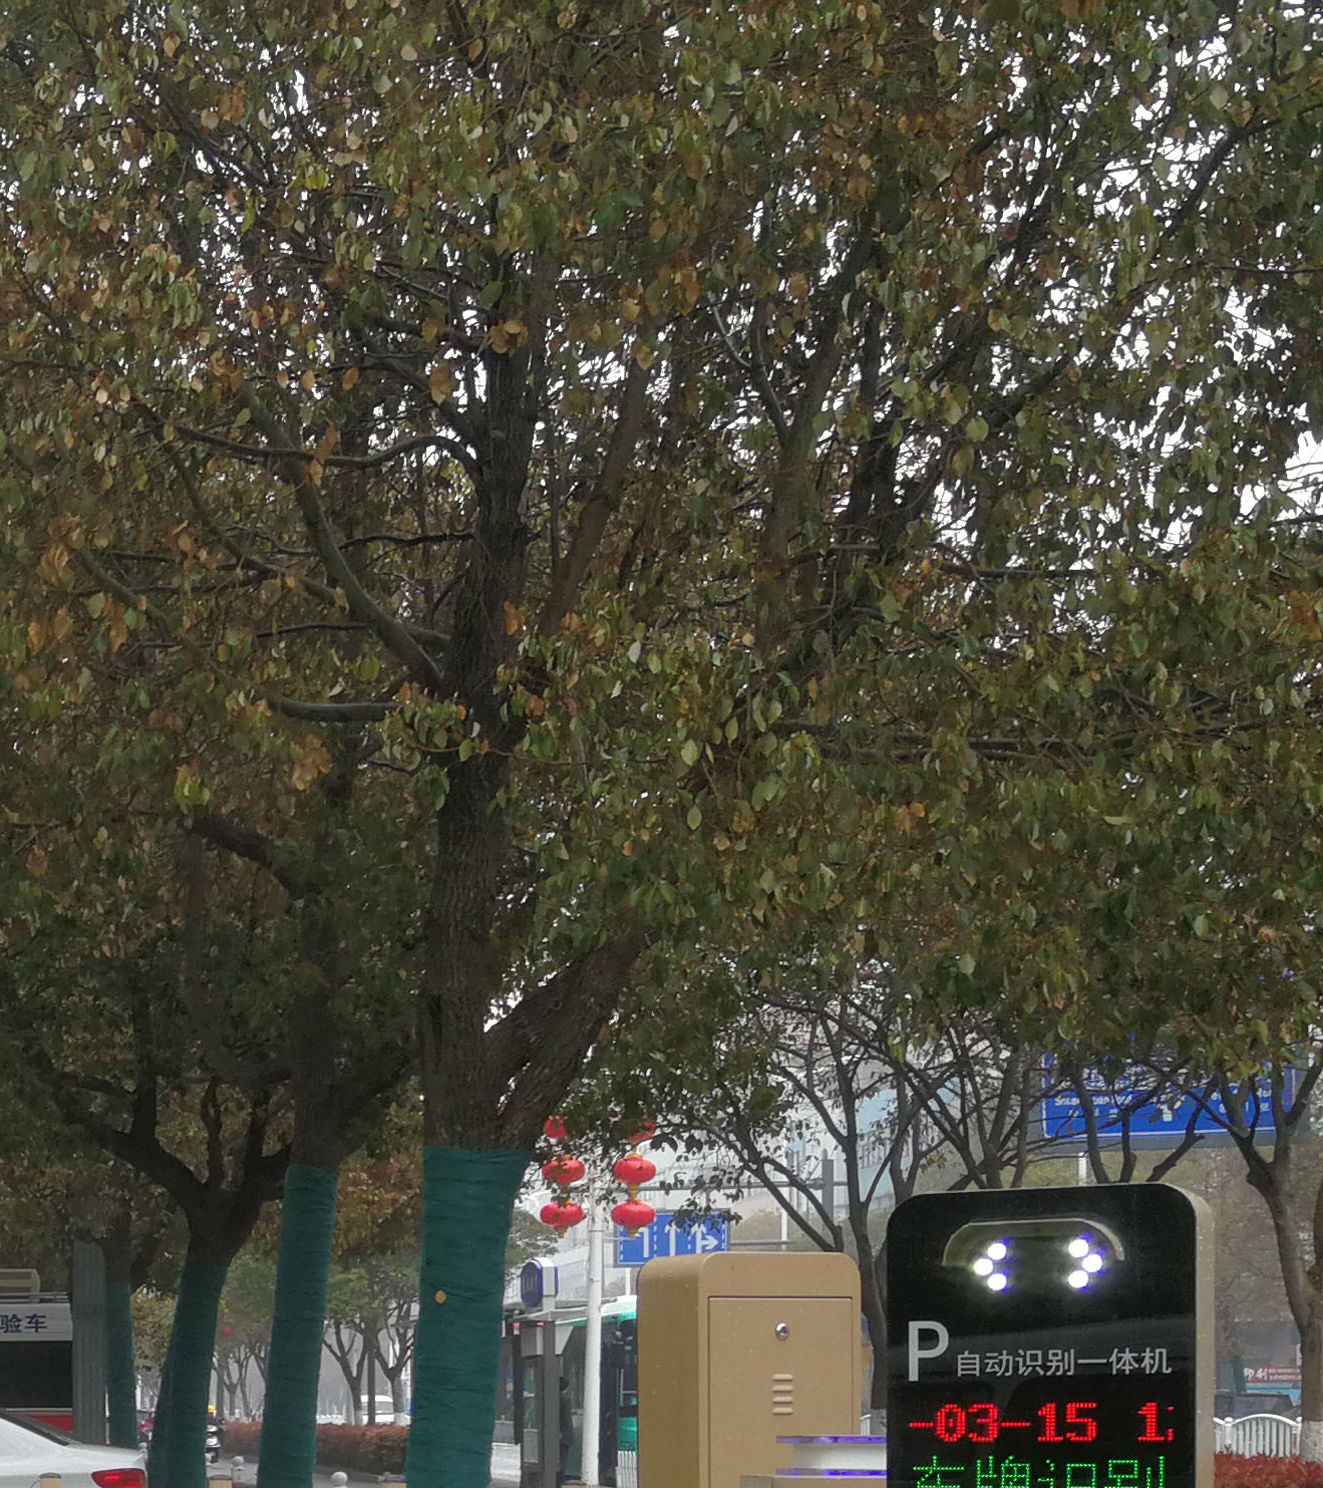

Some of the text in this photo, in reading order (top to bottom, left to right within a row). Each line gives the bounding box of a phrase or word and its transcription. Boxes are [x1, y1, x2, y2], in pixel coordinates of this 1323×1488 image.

[908, 1321, 1173, 1382] P 自动识别一体机
